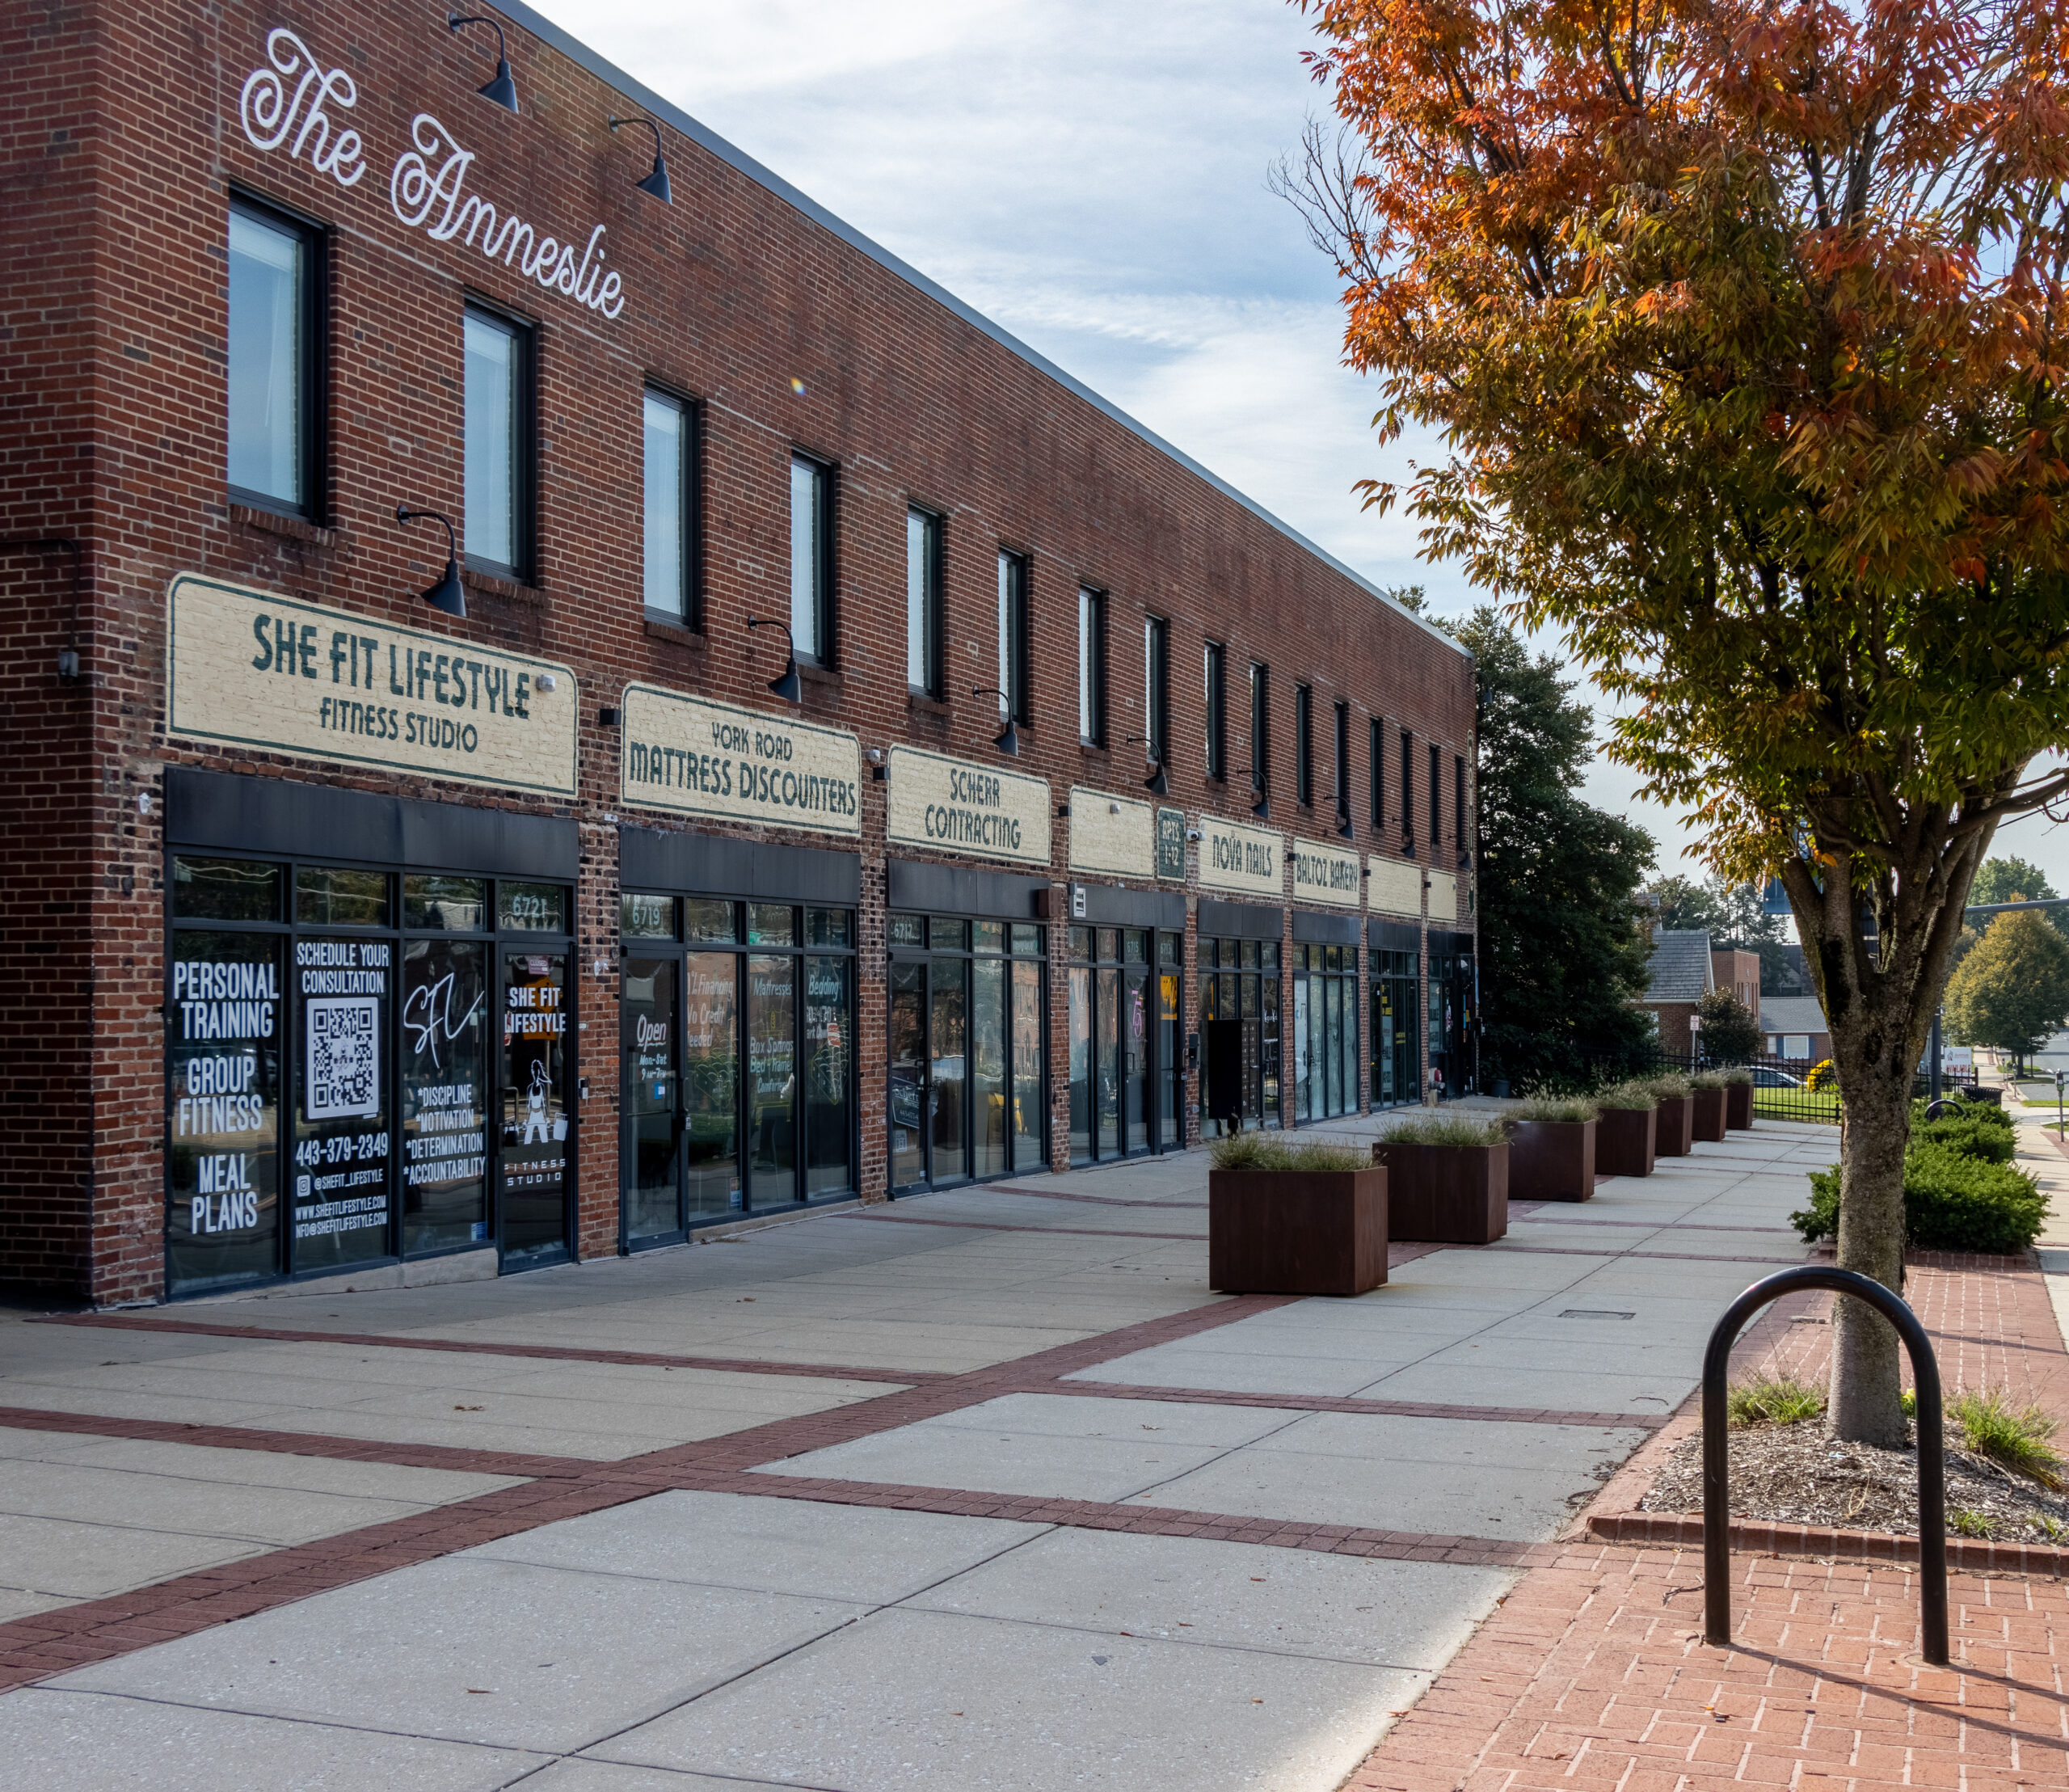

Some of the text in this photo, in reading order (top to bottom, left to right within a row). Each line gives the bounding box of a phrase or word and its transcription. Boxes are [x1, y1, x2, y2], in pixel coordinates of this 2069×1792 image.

[241, 27, 625, 319] The Anneslie
[252, 613, 530, 719] SHE FIT LIFESTYLE
[319, 696, 478, 753] FITNESS STUDIO
[711, 721, 793, 762] YORK ROAD
[630, 740, 856, 816] MATTRESS DISCOUNTERS
[950, 768, 1000, 807] SCHERR
[925, 804, 1021, 850] CONTRACTING
[1165, 845, 1179, 866] 1-12
[1213, 834, 1272, 878] NOVA NAILS
[1297, 853, 1358, 892] BALTOZ BAKERY
[513, 895, 546, 918] 6721
[633, 905, 660, 925] 6719
[895, 923, 912, 938] 6717
[297, 942, 390, 967] SCHEDULE YOUR
[1127, 941, 1139, 953] 6715
[174, 961, 280, 1000] PERSONAL
[302, 970, 385, 993] CONSULTATION
[698, 973, 734, 1002] Financing
[753, 977, 793, 997] Mattresses
[808, 974, 839, 1001] Bedding
[509, 987, 561, 1007] SHE FIT
[180, 1001, 273, 1039] TRAINING
[504, 1013, 566, 1033] LIFESTYLE
[700, 1002, 725, 1025] Credit
[637, 1014, 667, 1052] Open
[687, 1027, 714, 1048] eeded
[749, 1036, 794, 1057] Box Springs
[188, 1056, 255, 1095] GROUP
[749, 1056, 765, 1073] Bed
[179, 1094, 263, 1136] FITNESS
[296, 1132, 388, 1166] 443-379-2349
[199, 1153, 251, 1194] MEAL
[314, 1168, 384, 1191] @SHEFIT_LIFESTYLE
[507, 1172, 561, 1187] STUDIO
[192, 1191, 258, 1234] PLANS
[295, 1195, 386, 1221] WWW.SHEFITLIFESTYLE.COM
[296, 1212, 388, 1238] NFO@SHEFITLIFESTYLE.COM
